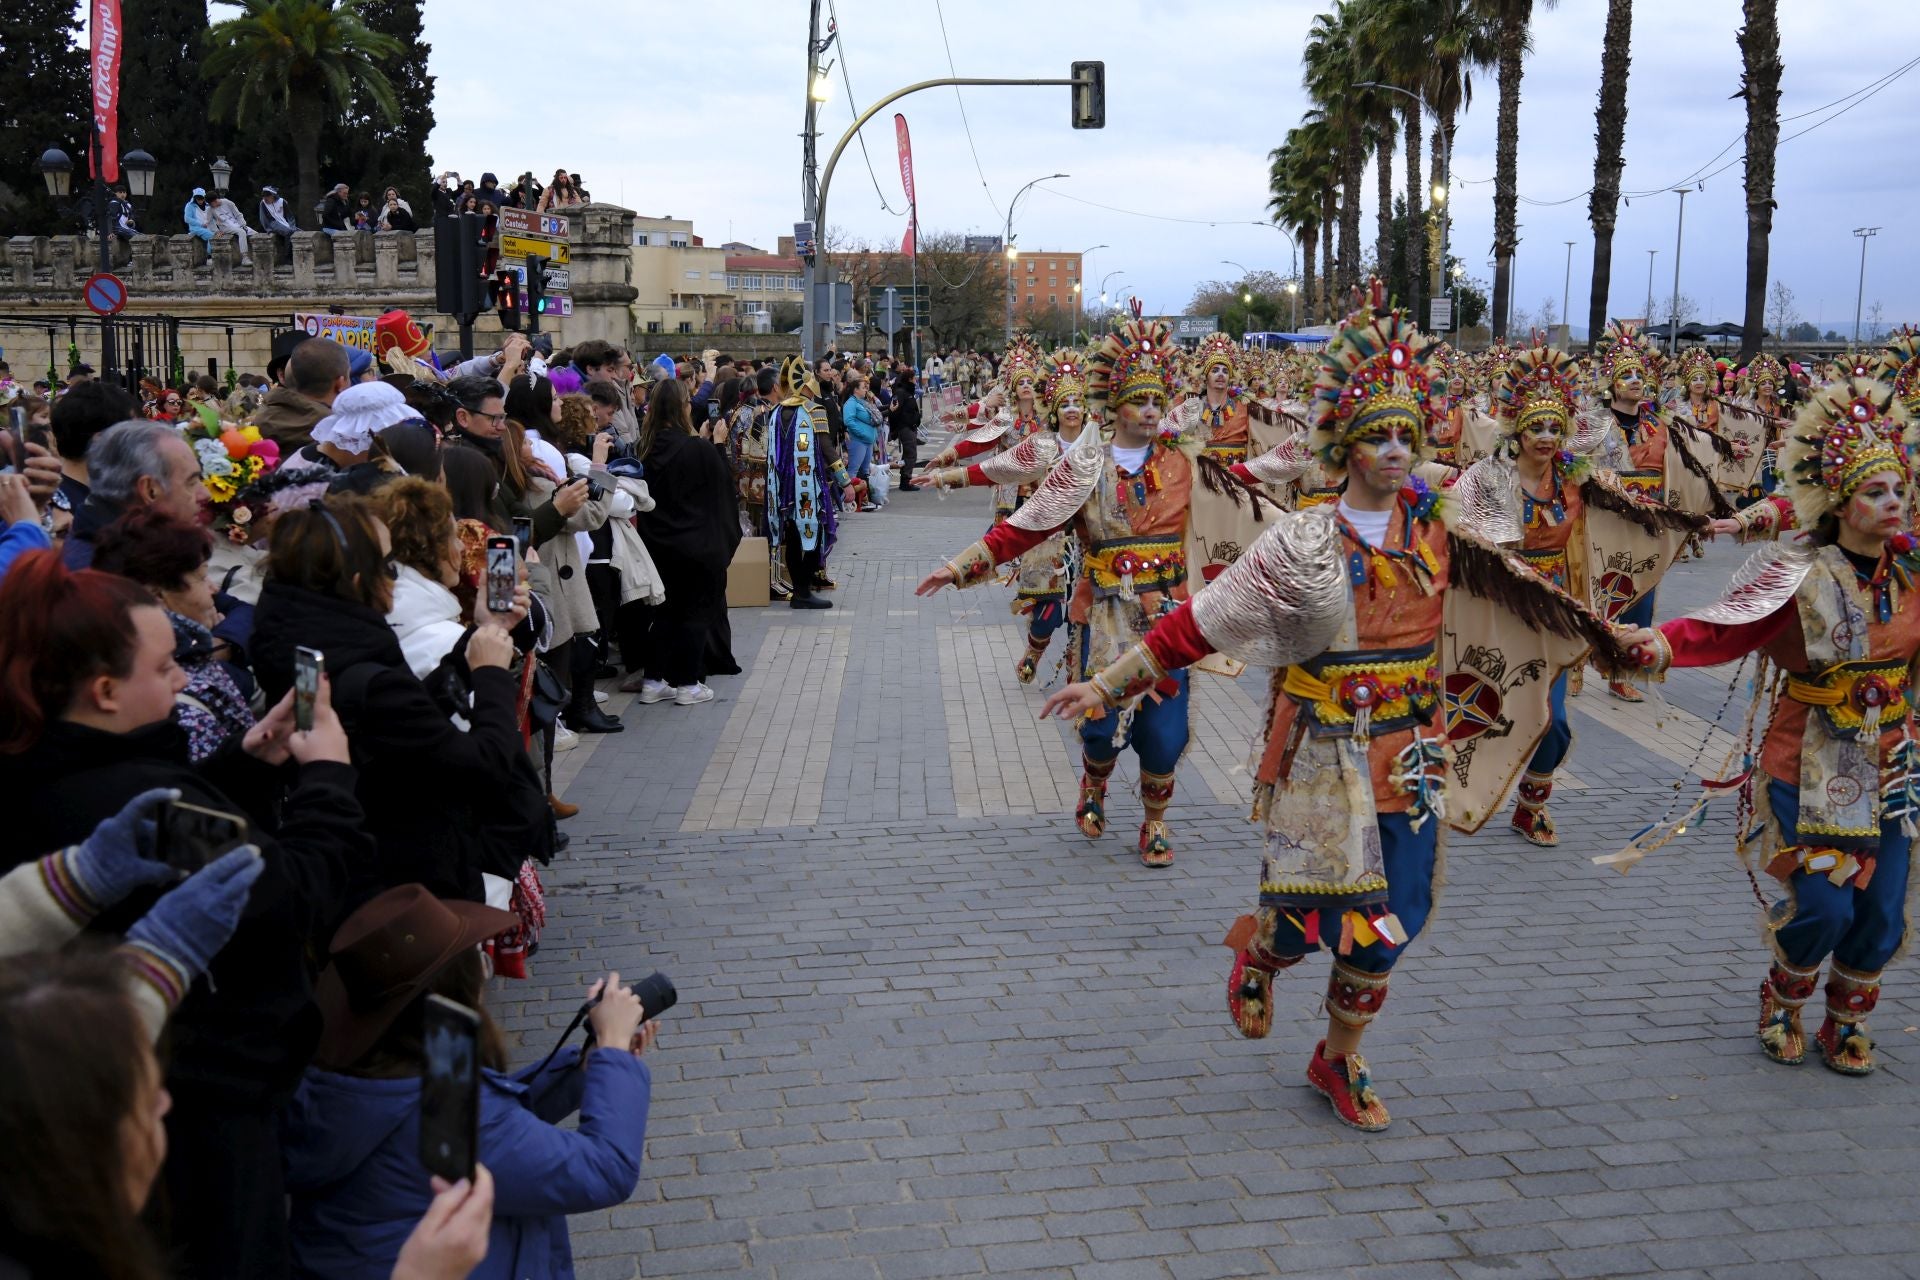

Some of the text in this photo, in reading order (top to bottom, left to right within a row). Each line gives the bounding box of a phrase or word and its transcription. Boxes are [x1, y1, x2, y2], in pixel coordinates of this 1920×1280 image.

[505, 218, 528, 230] Castelar
[548, 280, 568, 288] ovincial
[322, 316, 360, 328] COMPARSA
